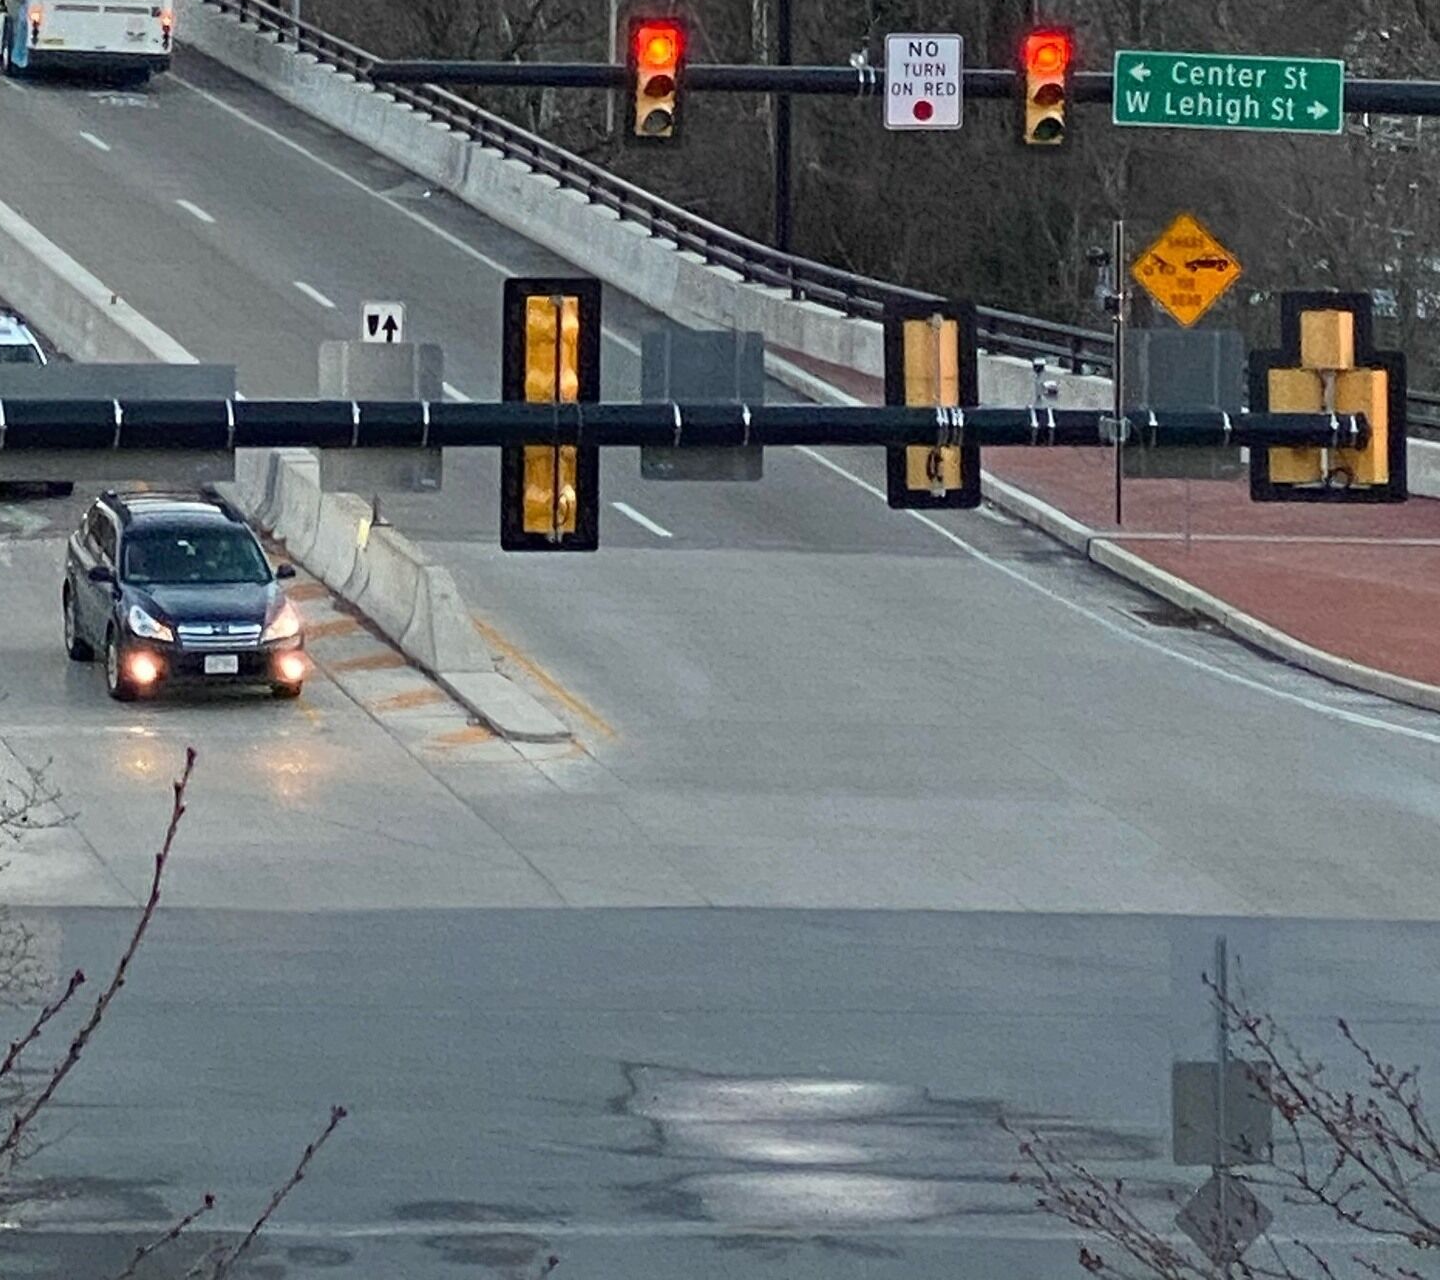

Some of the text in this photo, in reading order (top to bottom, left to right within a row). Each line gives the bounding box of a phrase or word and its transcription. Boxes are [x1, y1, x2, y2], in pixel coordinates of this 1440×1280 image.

[909, 41, 939, 57] NO
[903, 63, 946, 77] TURN
[1172, 61, 1308, 90] Center St
[891, 82, 956, 96] ON RED
[1126, 91, 1294, 124] W Lehigh St
